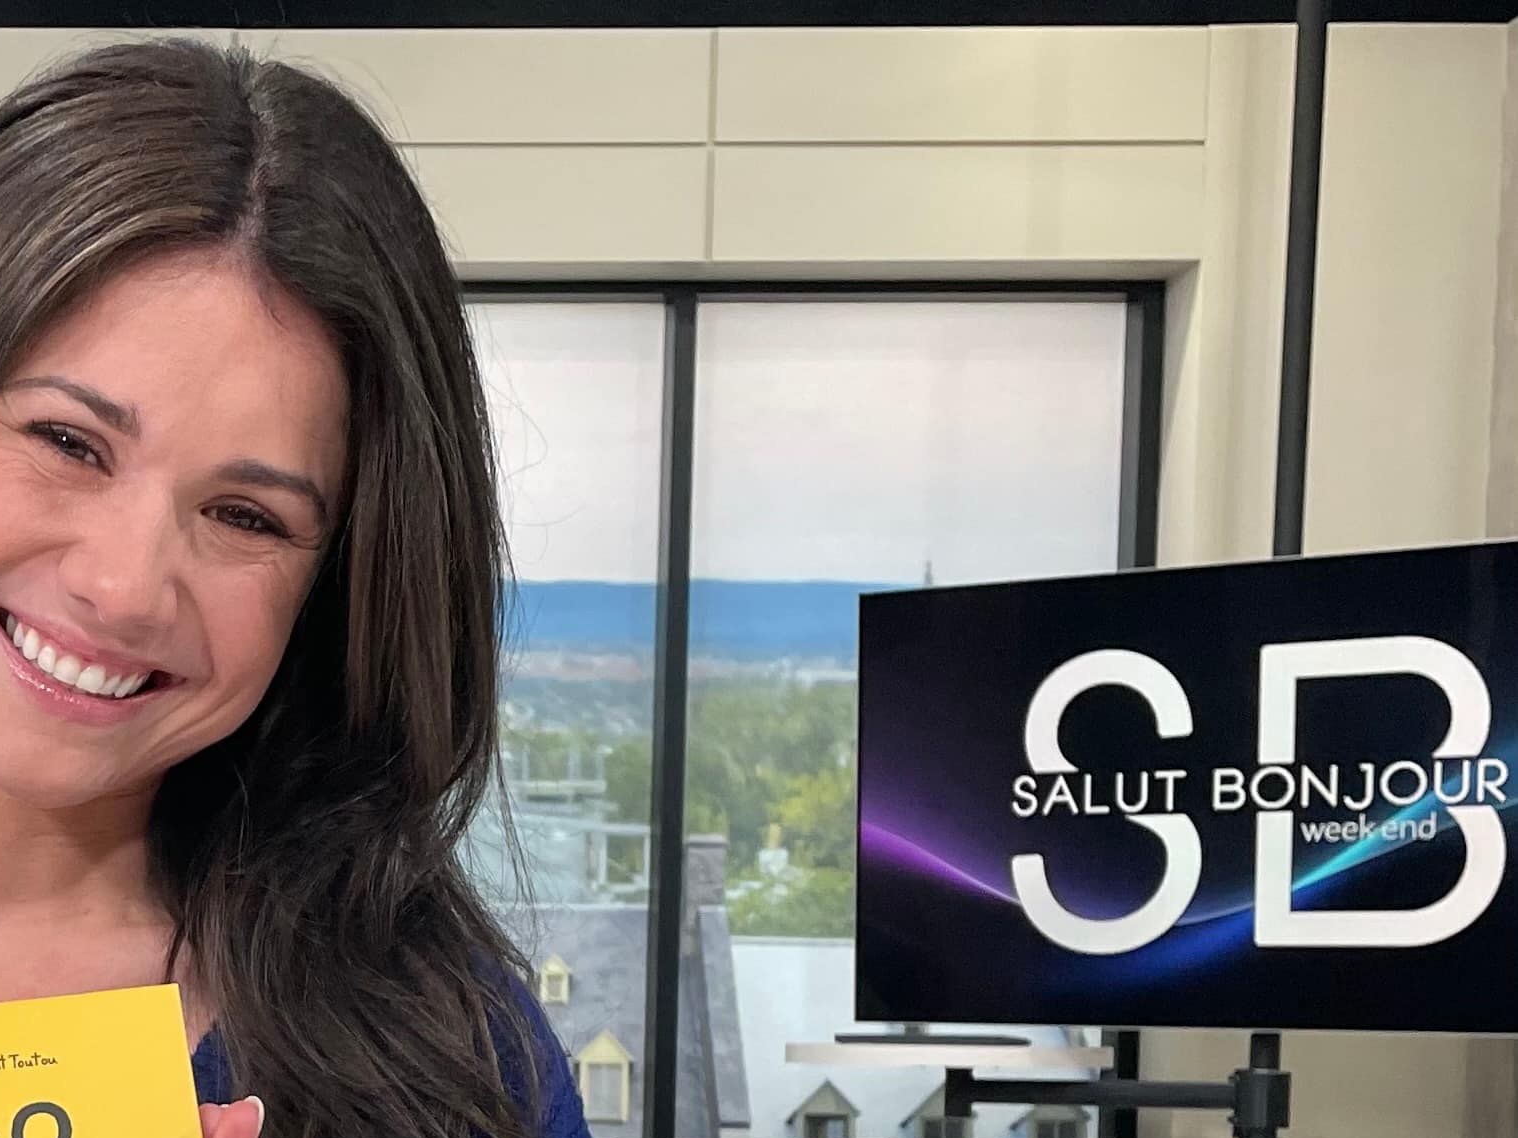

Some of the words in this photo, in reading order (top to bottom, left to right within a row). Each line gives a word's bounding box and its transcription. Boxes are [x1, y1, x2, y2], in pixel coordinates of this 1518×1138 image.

[1012, 770, 1187, 816] SALUT
[1211, 757, 1509, 811] BONJOUR
[9, 1052, 59, 1069] Toutou
